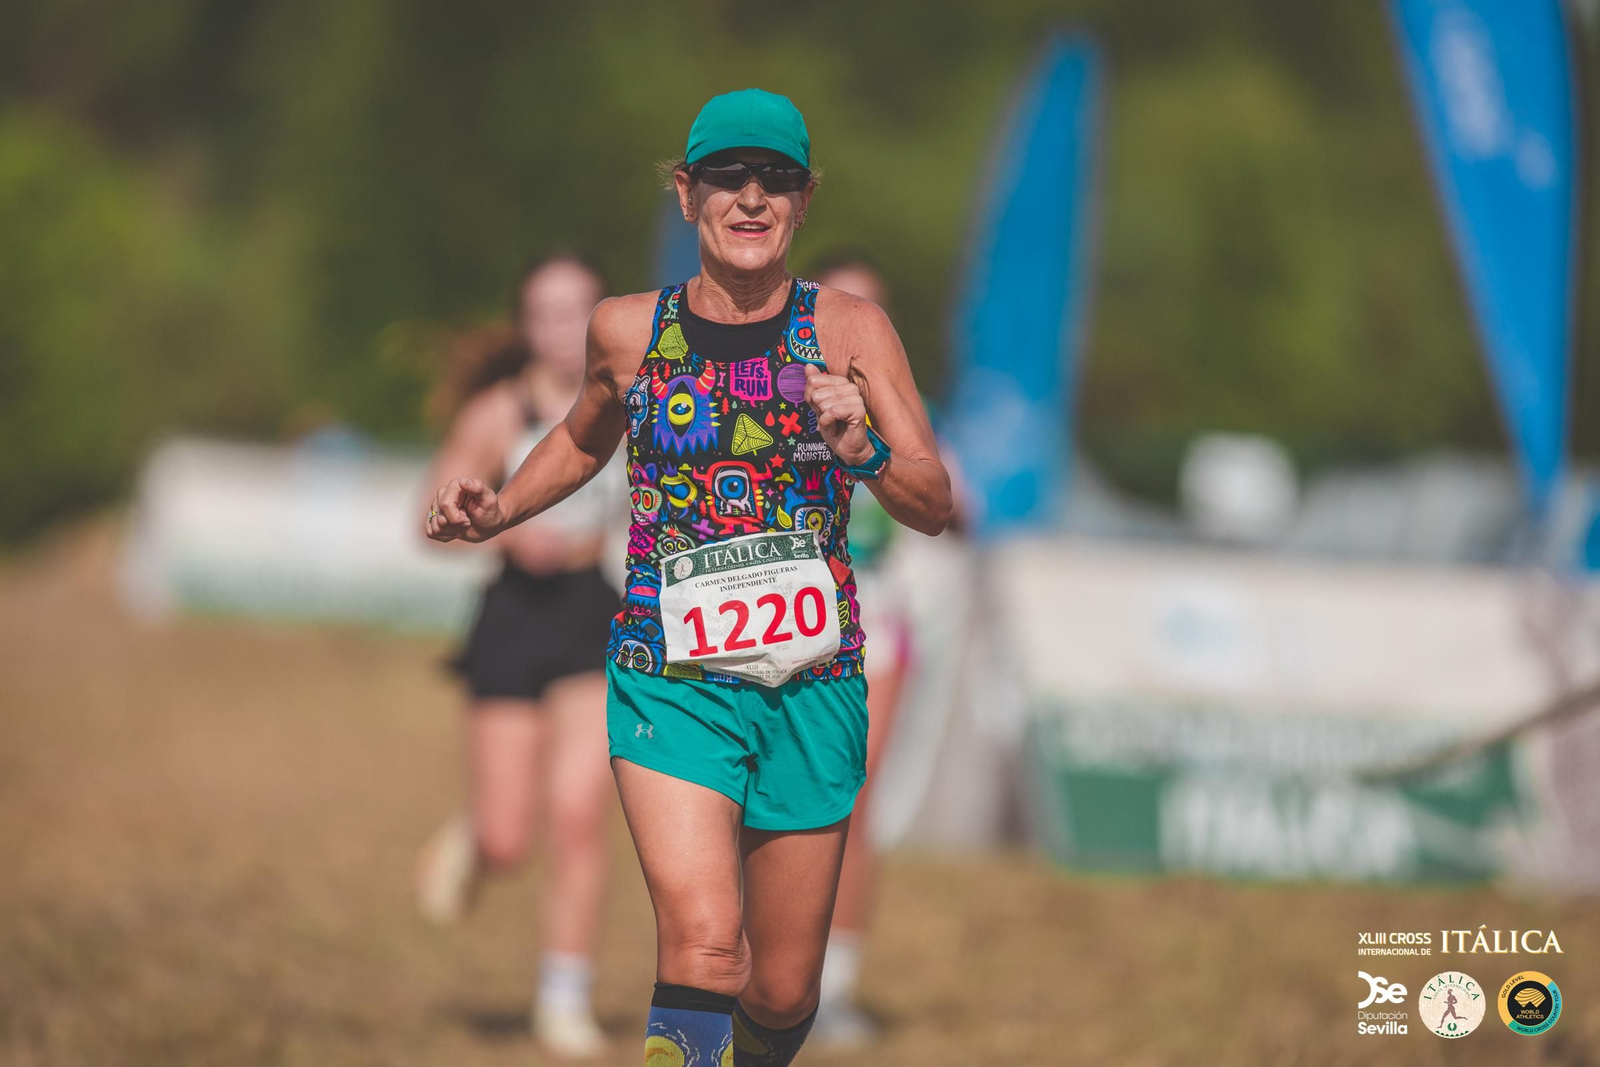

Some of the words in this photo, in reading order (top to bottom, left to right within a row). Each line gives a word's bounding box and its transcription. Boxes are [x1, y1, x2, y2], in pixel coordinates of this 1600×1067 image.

[735, 378, 768, 397] RUN
[793, 450, 832, 462] MONSTER
[797, 442, 827, 451] RUNNING
[704, 542, 782, 569] ITÁLICA
[694, 577, 726, 589] CARMEN
[727, 571, 763, 583] DELGADO
[763, 565, 798, 578] FIGUERAS
[720, 577, 777, 592] INDEPENDIENTE
[683, 586, 827, 658] 1220
